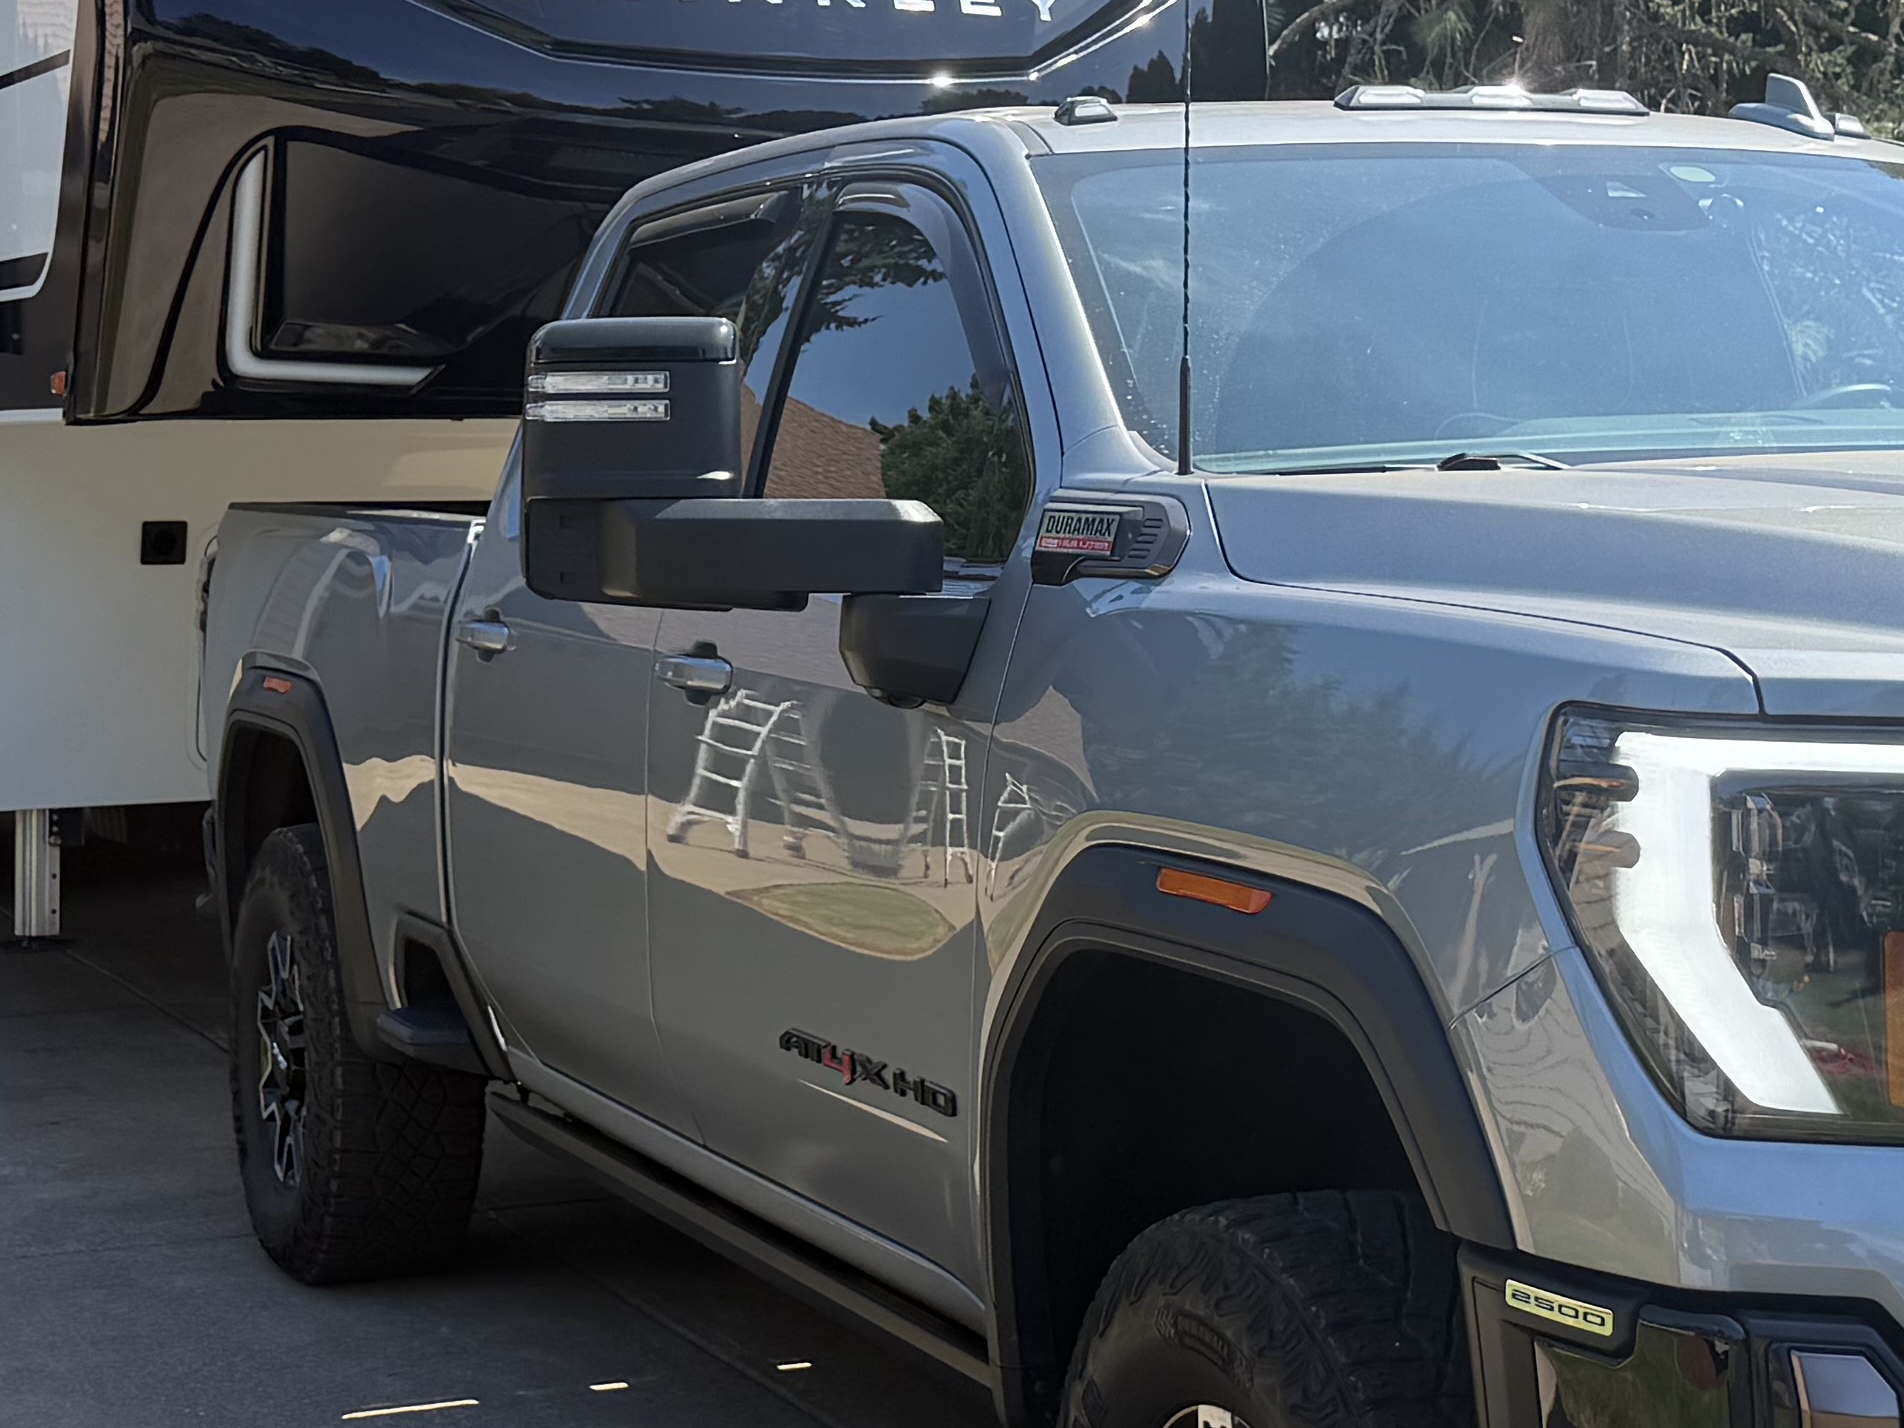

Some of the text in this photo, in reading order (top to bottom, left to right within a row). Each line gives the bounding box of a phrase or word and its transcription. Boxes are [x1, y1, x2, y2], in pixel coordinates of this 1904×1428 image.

[1045, 515, 1115, 537] DURAMAX
[893, 1067, 958, 1117] HD
[1511, 1289, 1606, 1327] 2500
